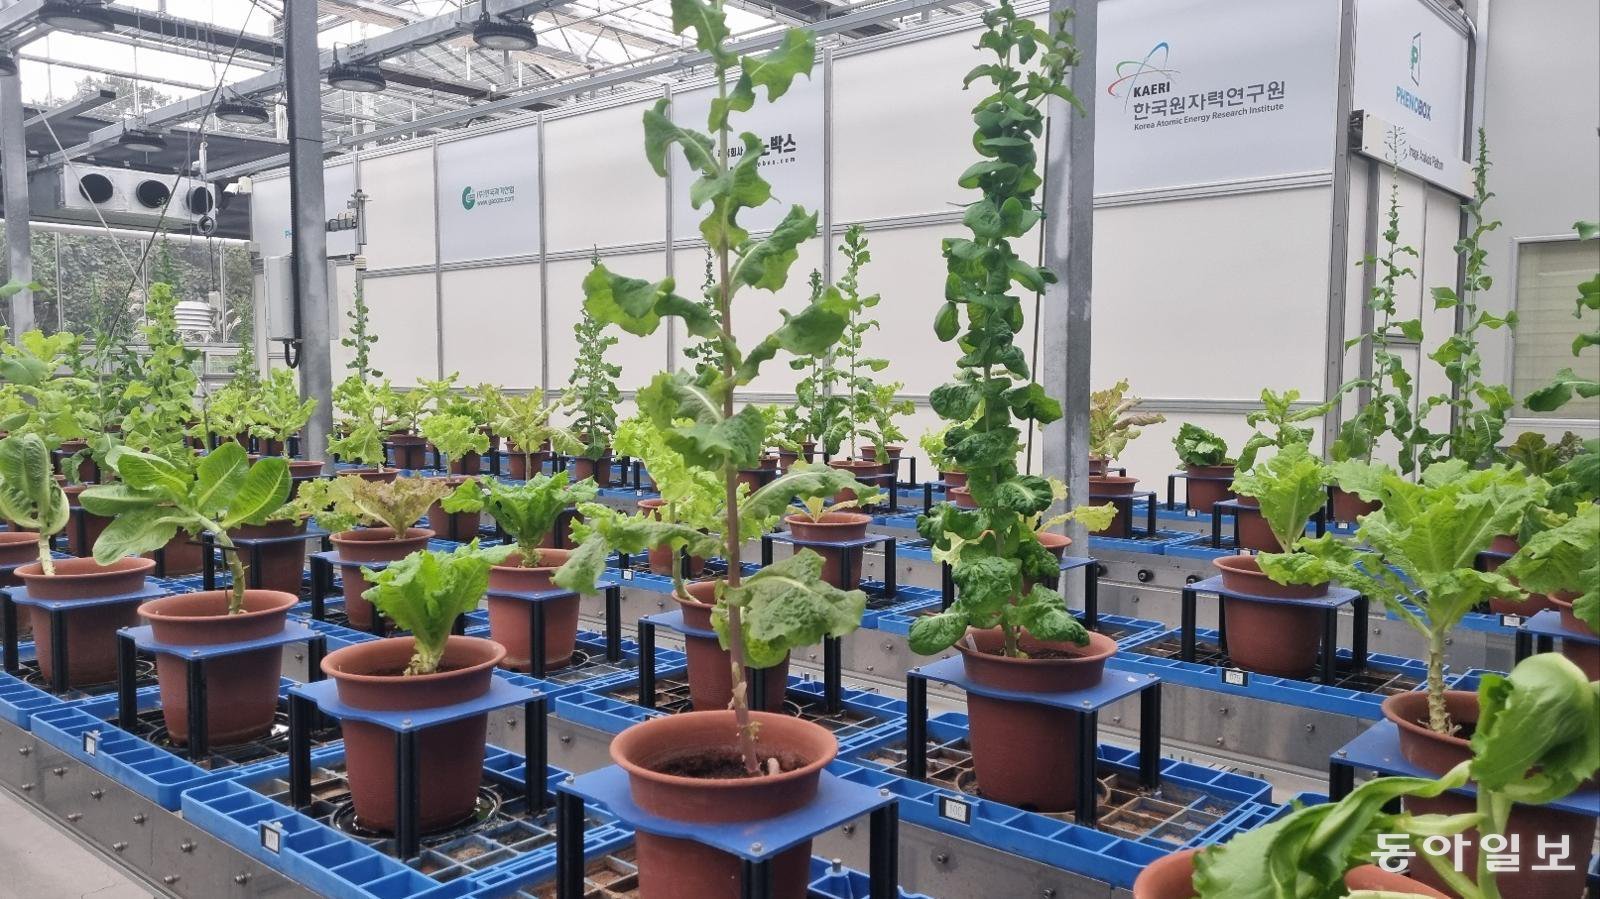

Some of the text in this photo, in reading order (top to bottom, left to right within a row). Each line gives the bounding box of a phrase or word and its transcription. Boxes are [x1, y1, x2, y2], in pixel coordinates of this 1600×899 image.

[1133, 81, 1171, 98] KAERI
[1133, 80, 1286, 121] 한국원자력연구원
[1395, 85, 1432, 121] PHENOBOX
[1134, 103, 1285, 131] Korea Atomic Energy Research Institute
